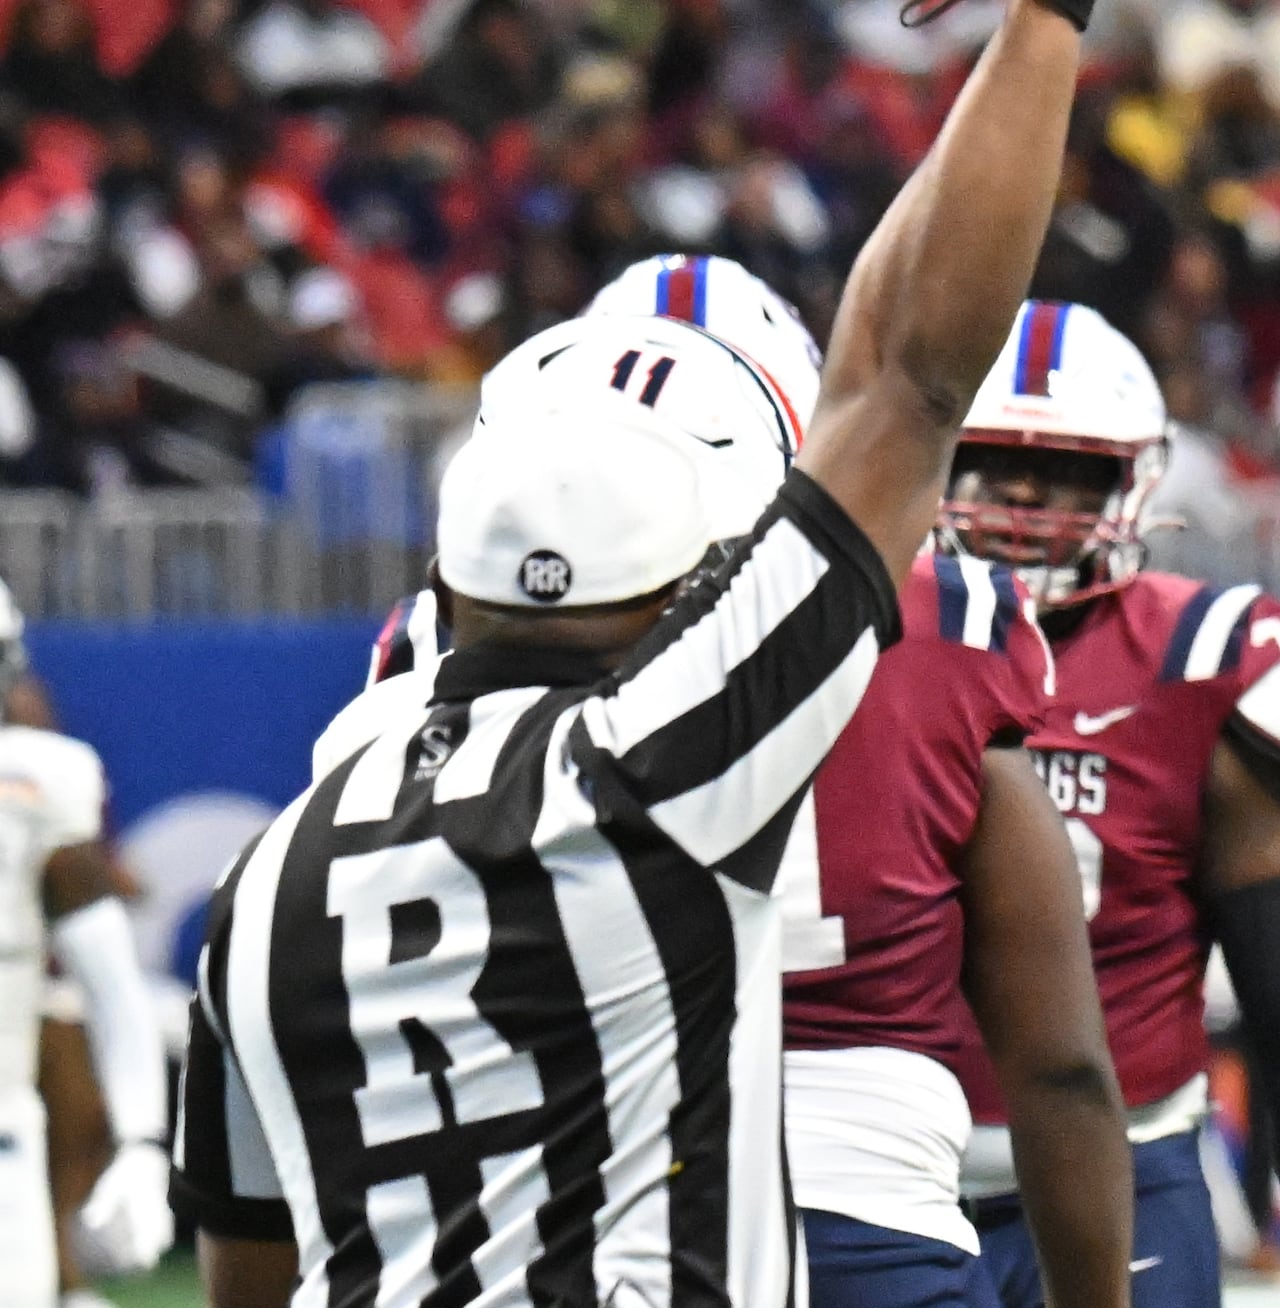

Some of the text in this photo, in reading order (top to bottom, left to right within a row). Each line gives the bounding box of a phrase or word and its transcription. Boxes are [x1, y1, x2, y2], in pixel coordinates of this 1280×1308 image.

[608, 349, 676, 410] 11
[524, 556, 569, 594] RR
[326, 836, 545, 1148] R
